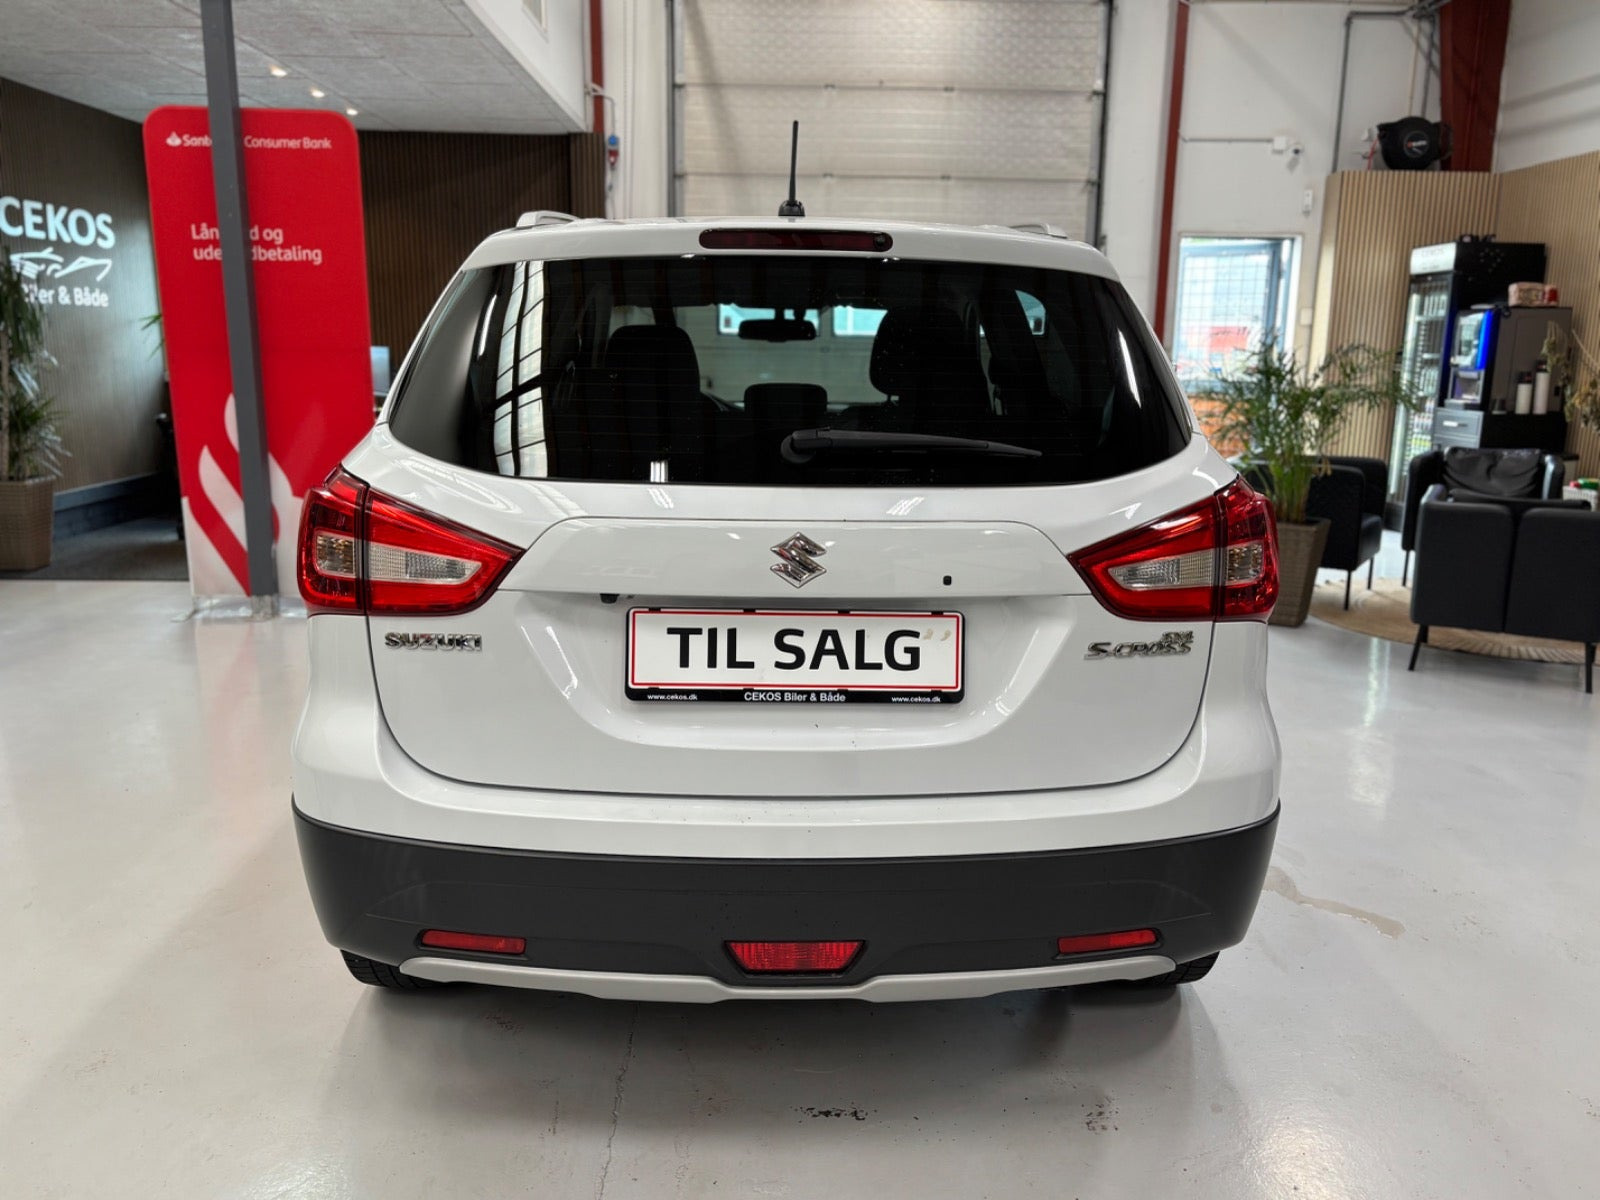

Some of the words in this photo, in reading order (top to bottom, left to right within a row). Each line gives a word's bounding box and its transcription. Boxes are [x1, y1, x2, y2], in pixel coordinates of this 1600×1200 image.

[244, 135, 301, 149] Consumer
[302, 137, 332, 149] Bank
[0, 196, 116, 249] CEKOS
[190, 222, 220, 240] Lån
[262, 228, 284, 245] og
[193, 244, 222, 261] ude
[251, 245, 323, 265] dbetaling
[58, 285, 71, 305] &
[73, 286, 109, 307] Både
[384, 632, 482, 651] SUZUKI
[667, 627, 755, 669] TIL
[773, 628, 922, 671] SALG
[744, 691, 782, 702] CEKOS
[784, 692, 808, 702] Biler
[809, 692, 818, 702] &
[819, 692, 847, 703] Både
[891, 695, 942, 703] www.cekos.dk
